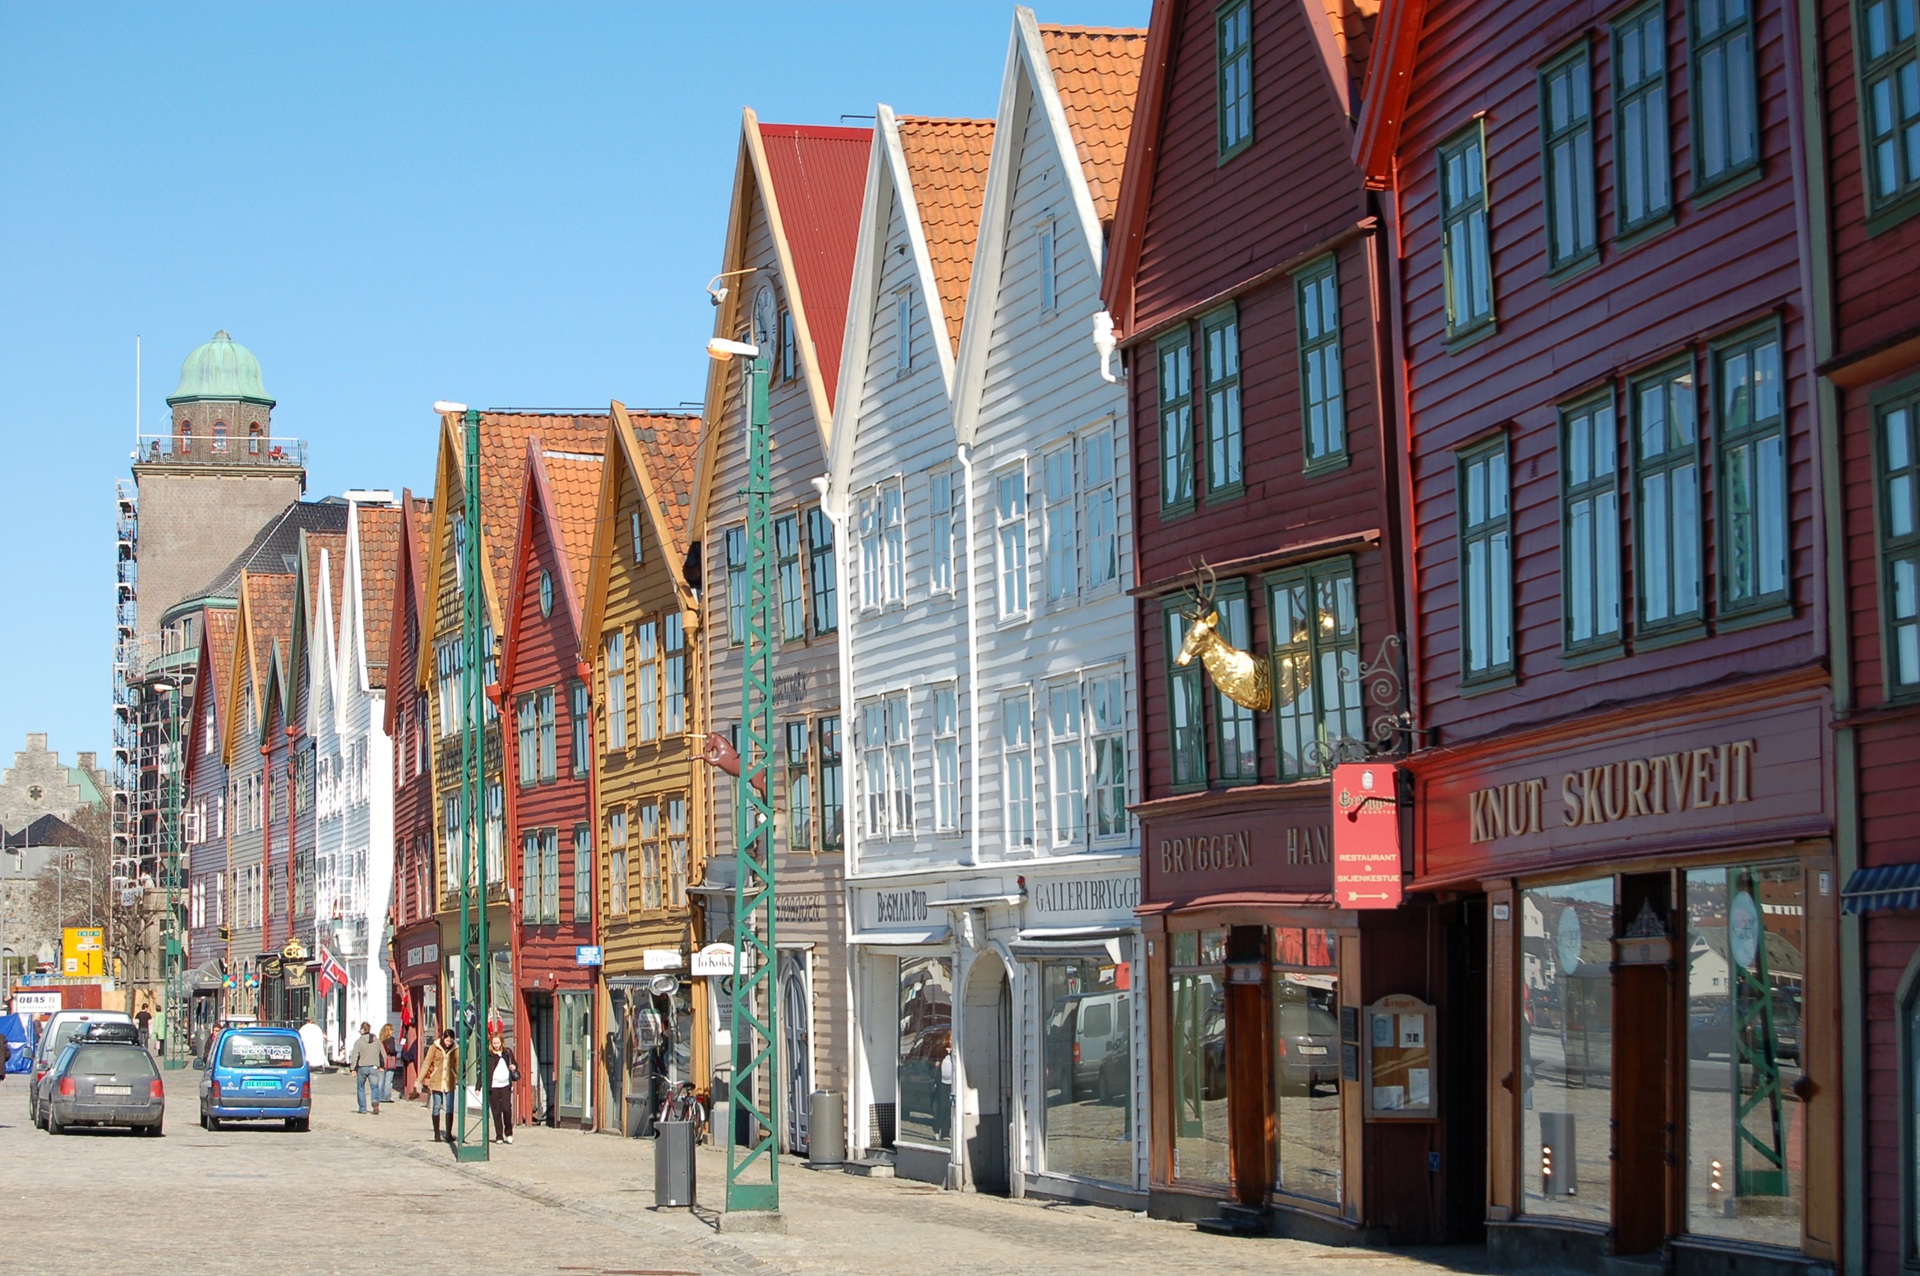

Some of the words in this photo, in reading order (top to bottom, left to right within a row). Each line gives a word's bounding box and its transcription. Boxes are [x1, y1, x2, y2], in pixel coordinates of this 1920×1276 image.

[1469, 777, 1547, 844] KNUT
[1561, 738, 1757, 828] SKURTVEIT
[1161, 830, 1253, 874] BRYGGEN
[1339, 853, 1397, 862] RESTAURANT
[1364, 864, 1372, 872] &
[1337, 874, 1400, 883] SKJENKESTUE
[911, 889, 928, 921] PUB
[709, 955, 743, 968] Kokk
[19, 996, 46, 1004] OBAS
